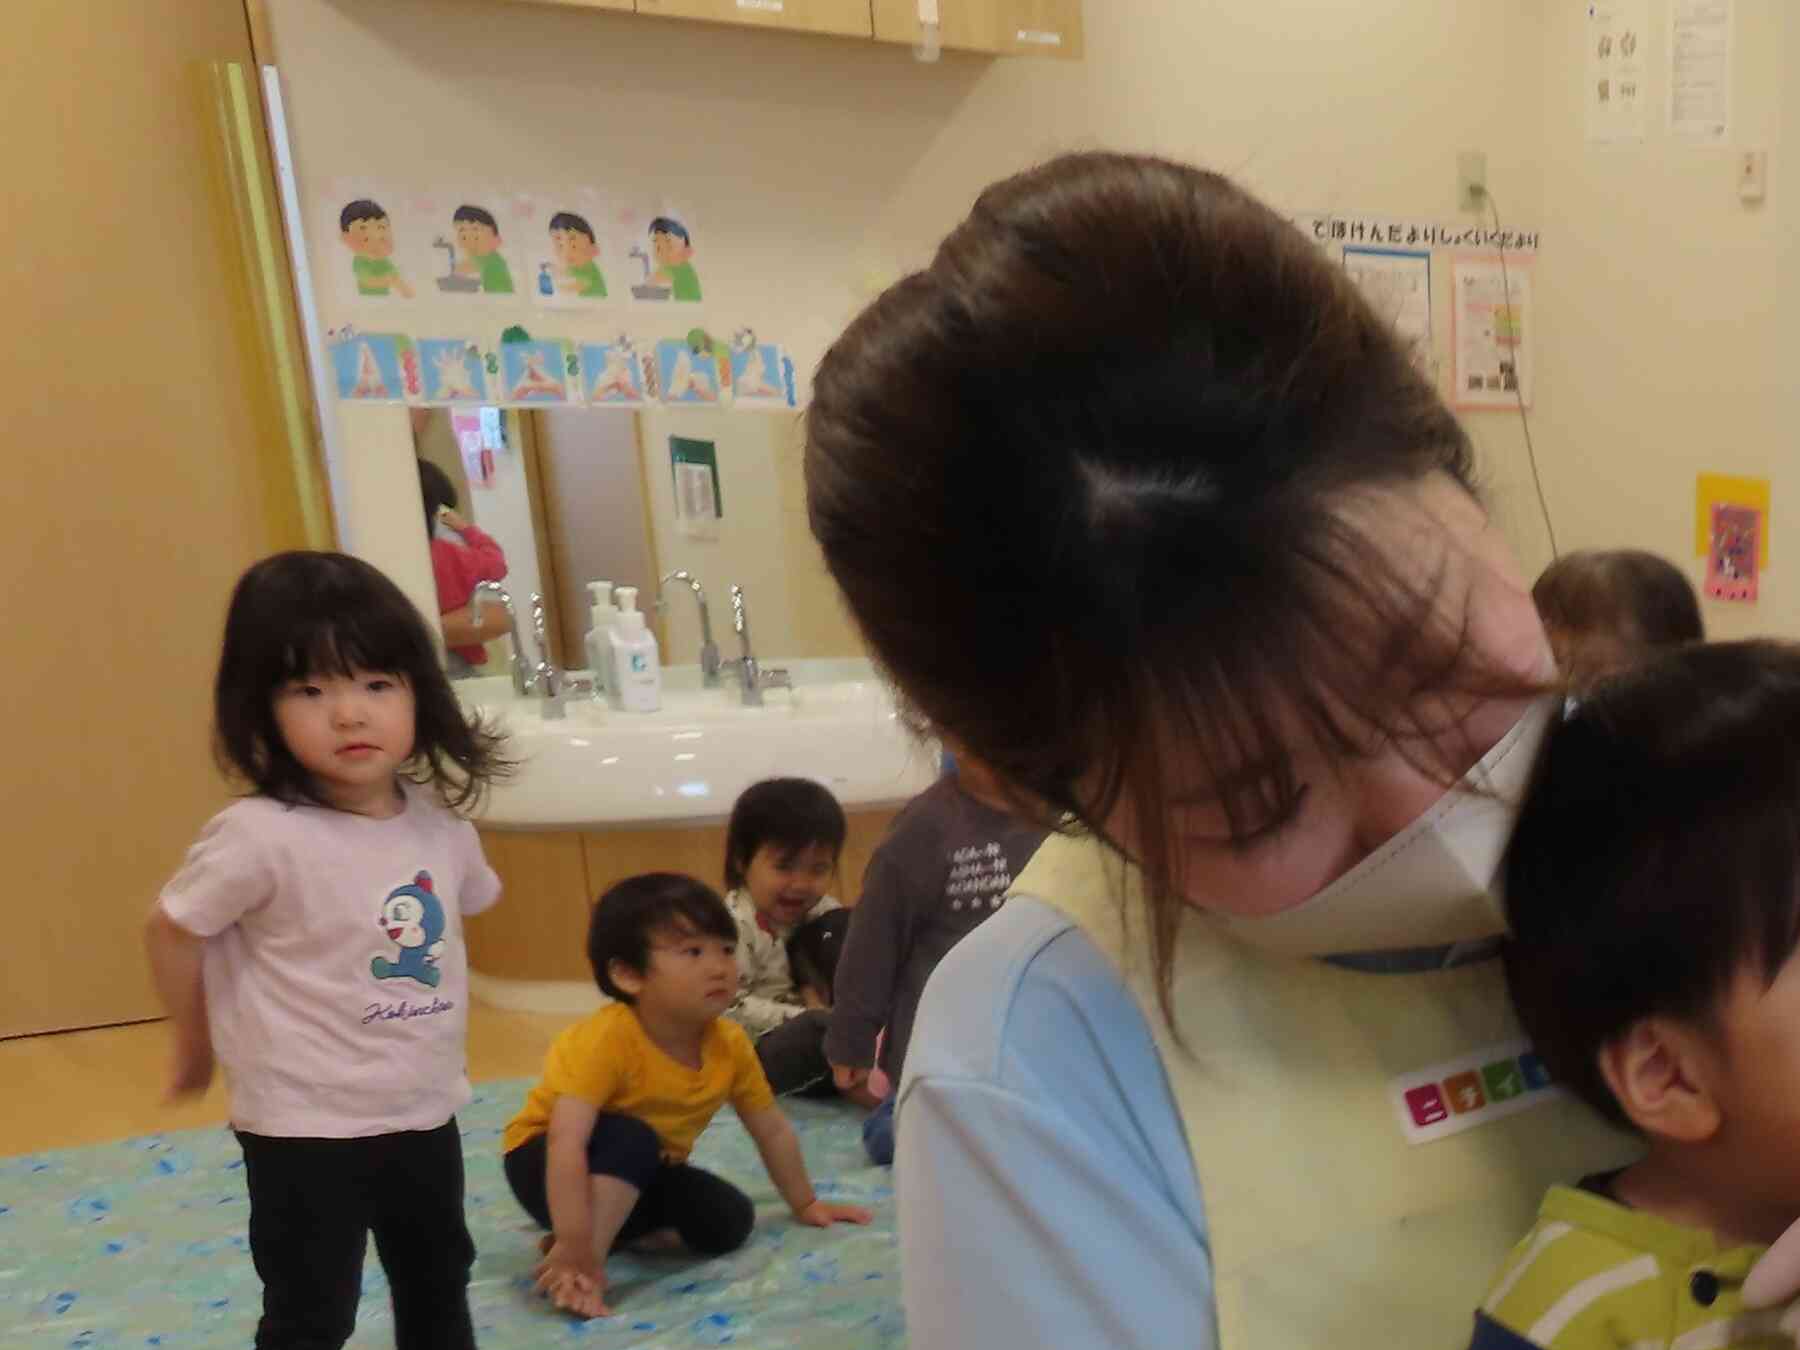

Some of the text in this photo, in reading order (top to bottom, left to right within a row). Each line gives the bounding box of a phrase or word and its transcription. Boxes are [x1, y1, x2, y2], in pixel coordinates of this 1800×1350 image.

[1331, 219, 1435, 246] ほけんだより
